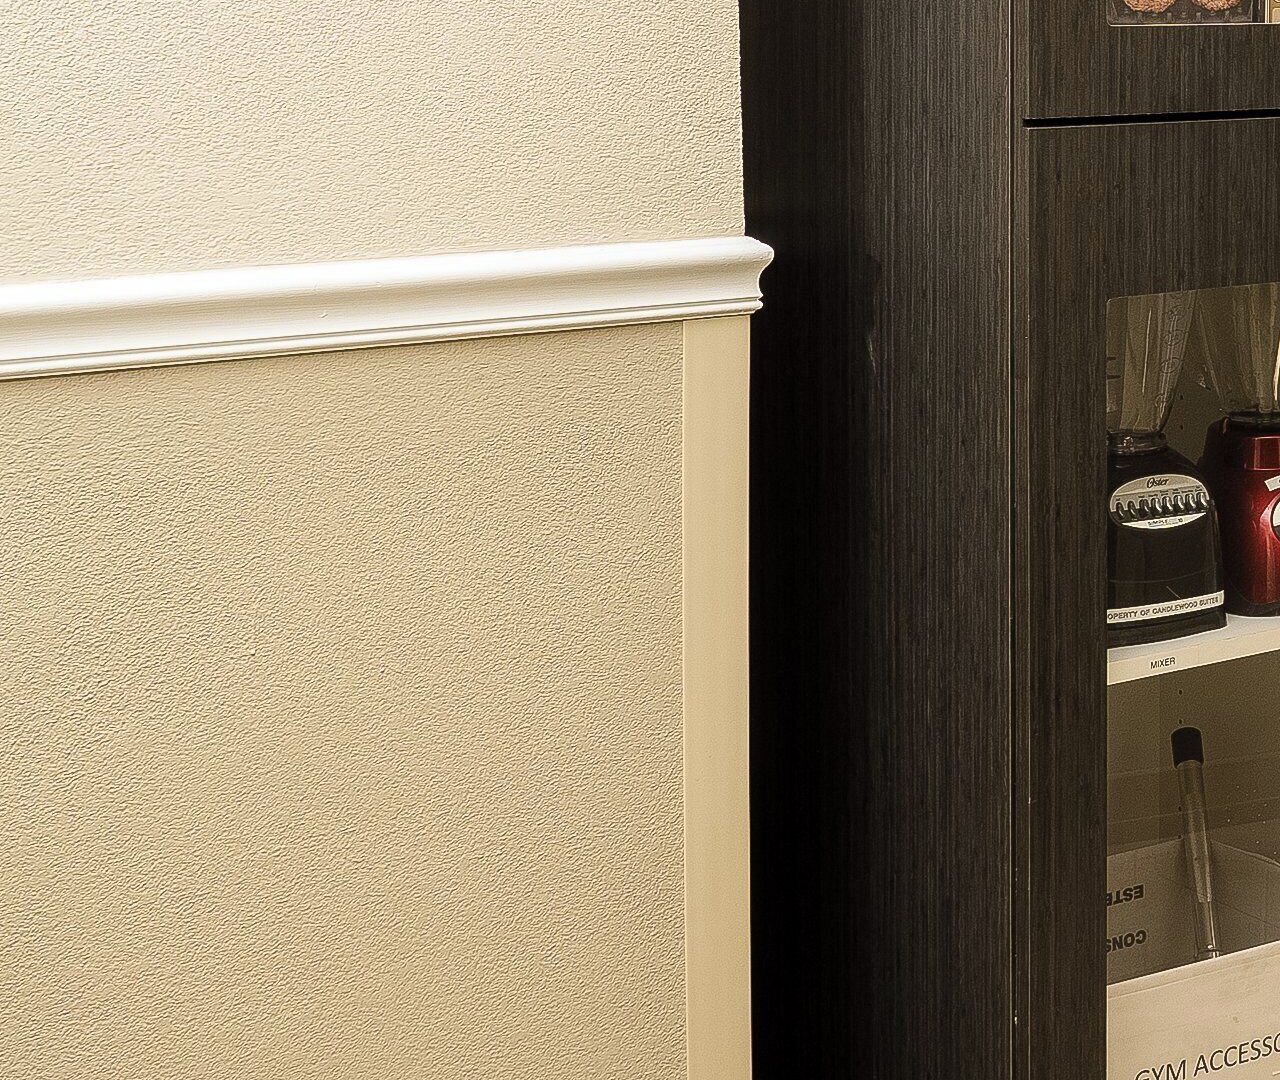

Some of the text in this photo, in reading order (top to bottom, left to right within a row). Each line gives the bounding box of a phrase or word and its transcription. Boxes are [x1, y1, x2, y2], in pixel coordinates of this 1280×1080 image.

[1146, 477, 1170, 488] Oster
[1108, 609, 1138, 620] OPERTY
[1140, 608, 1150, 616] OF
[1152, 600, 1198, 615] CANDLEWOOD
[1150, 656, 1176, 670] MIXER
[1134, 1058, 1187, 1080] GYM
